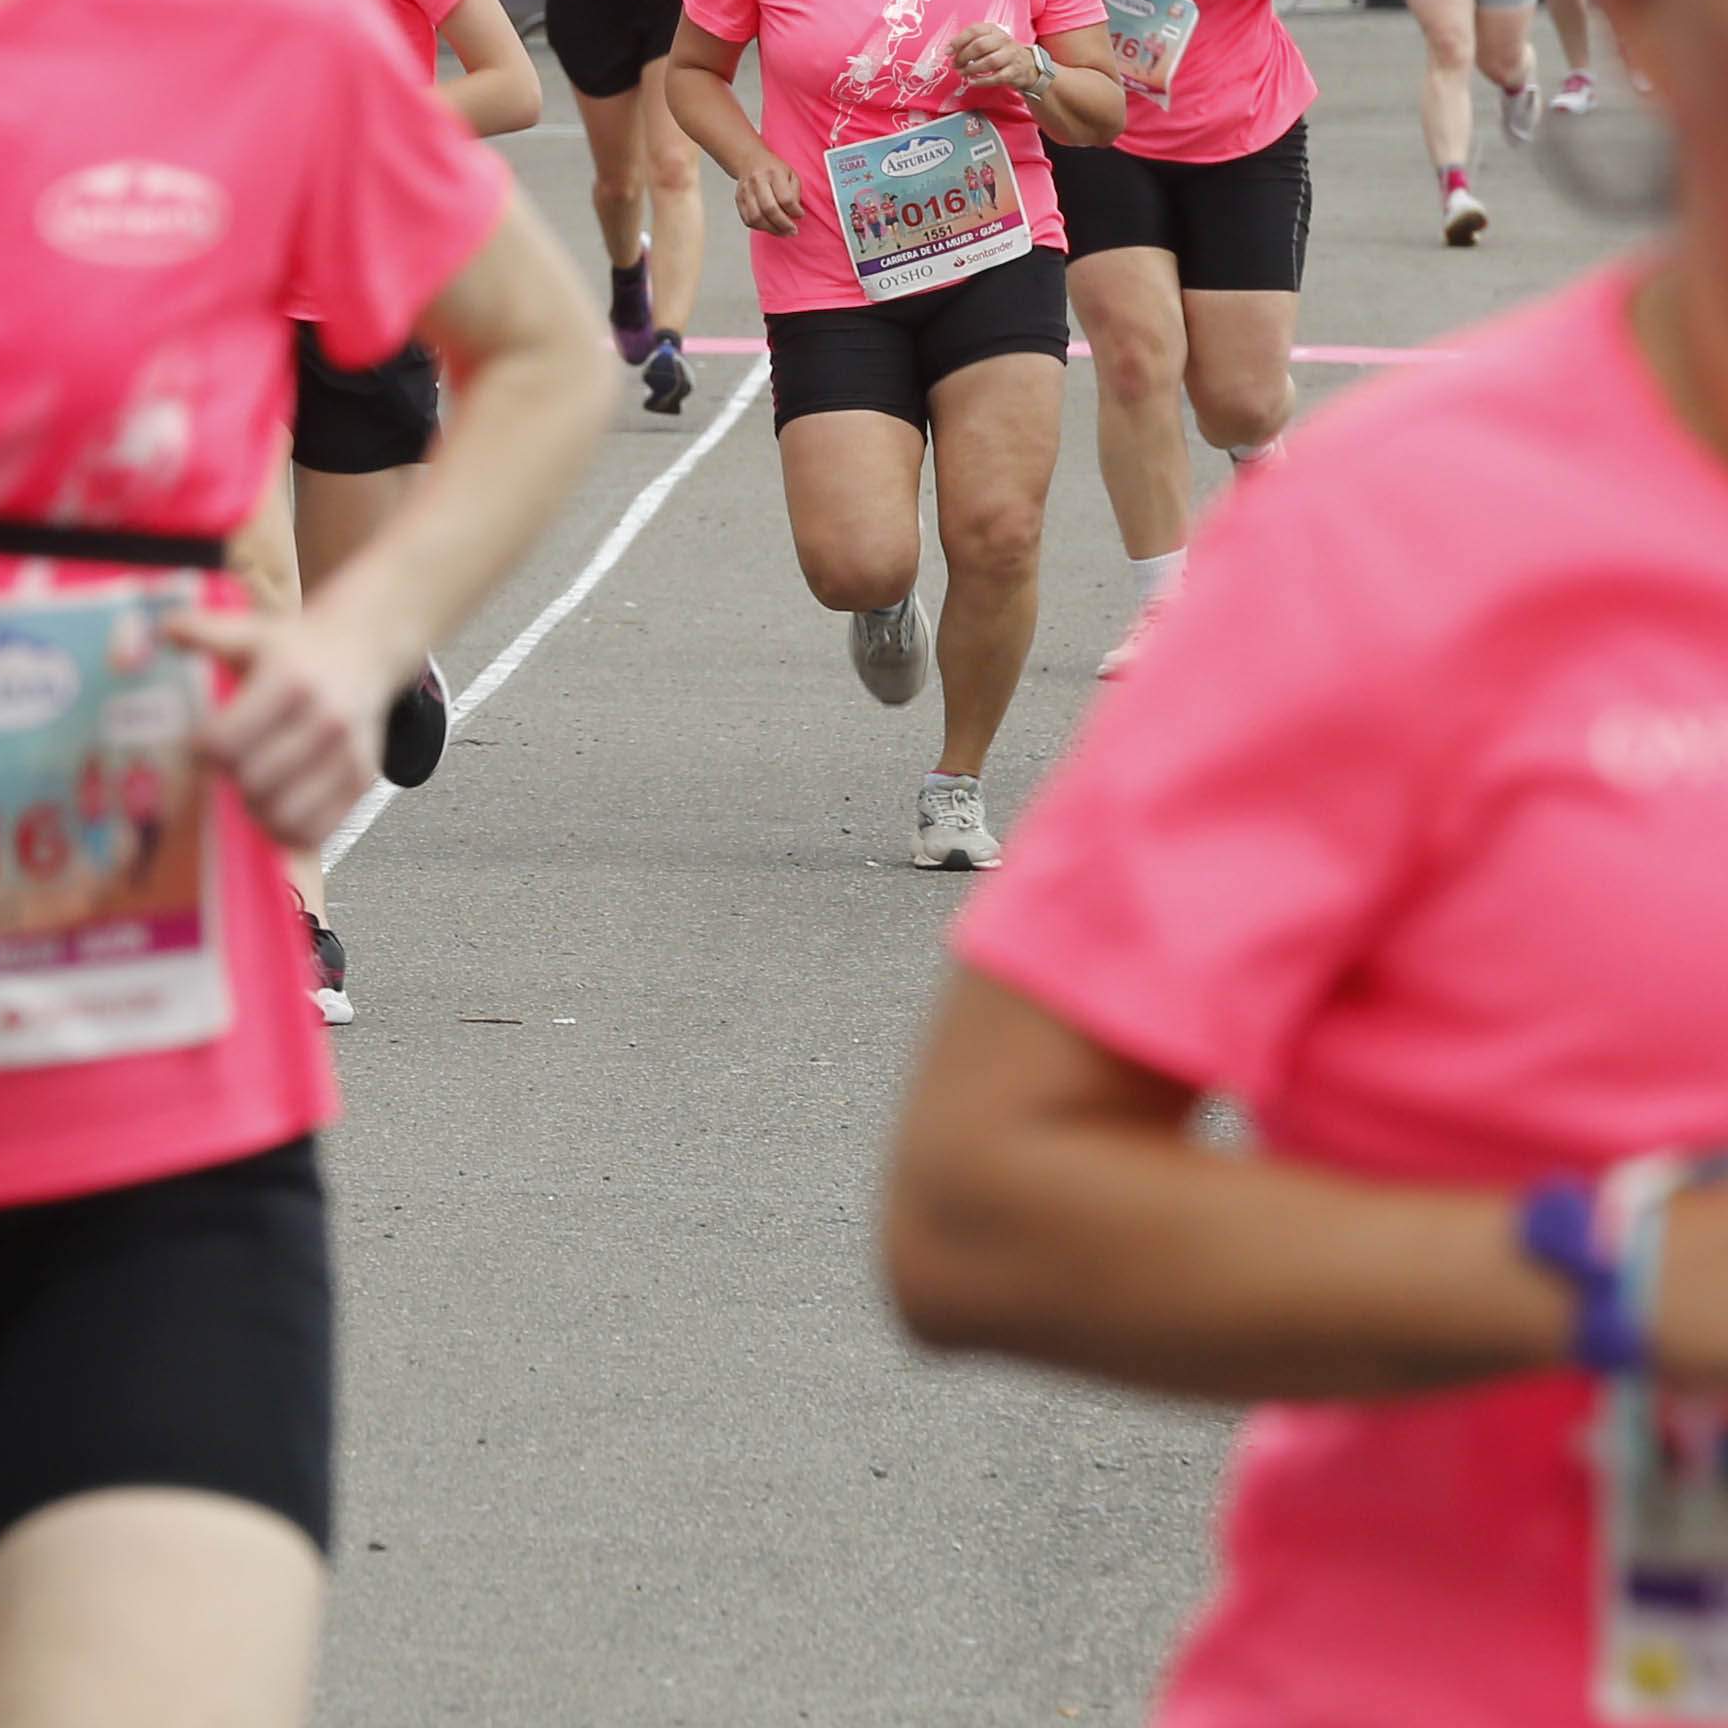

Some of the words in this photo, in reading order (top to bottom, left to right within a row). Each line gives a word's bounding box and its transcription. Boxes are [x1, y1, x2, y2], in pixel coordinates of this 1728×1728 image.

[1109, 31, 1140, 60] 16
[886, 145, 951, 174] ASTURIANA
[901, 188, 967, 228] 016
[923, 224, 954, 242] 1551
[880, 249, 920, 268] CARRERA
[920, 247, 932, 258] DE
[933, 242, 945, 253] LA
[946, 234, 974, 249] MUJER
[965, 240, 1015, 265] Santander
[879, 265, 934, 291] OYSHO
